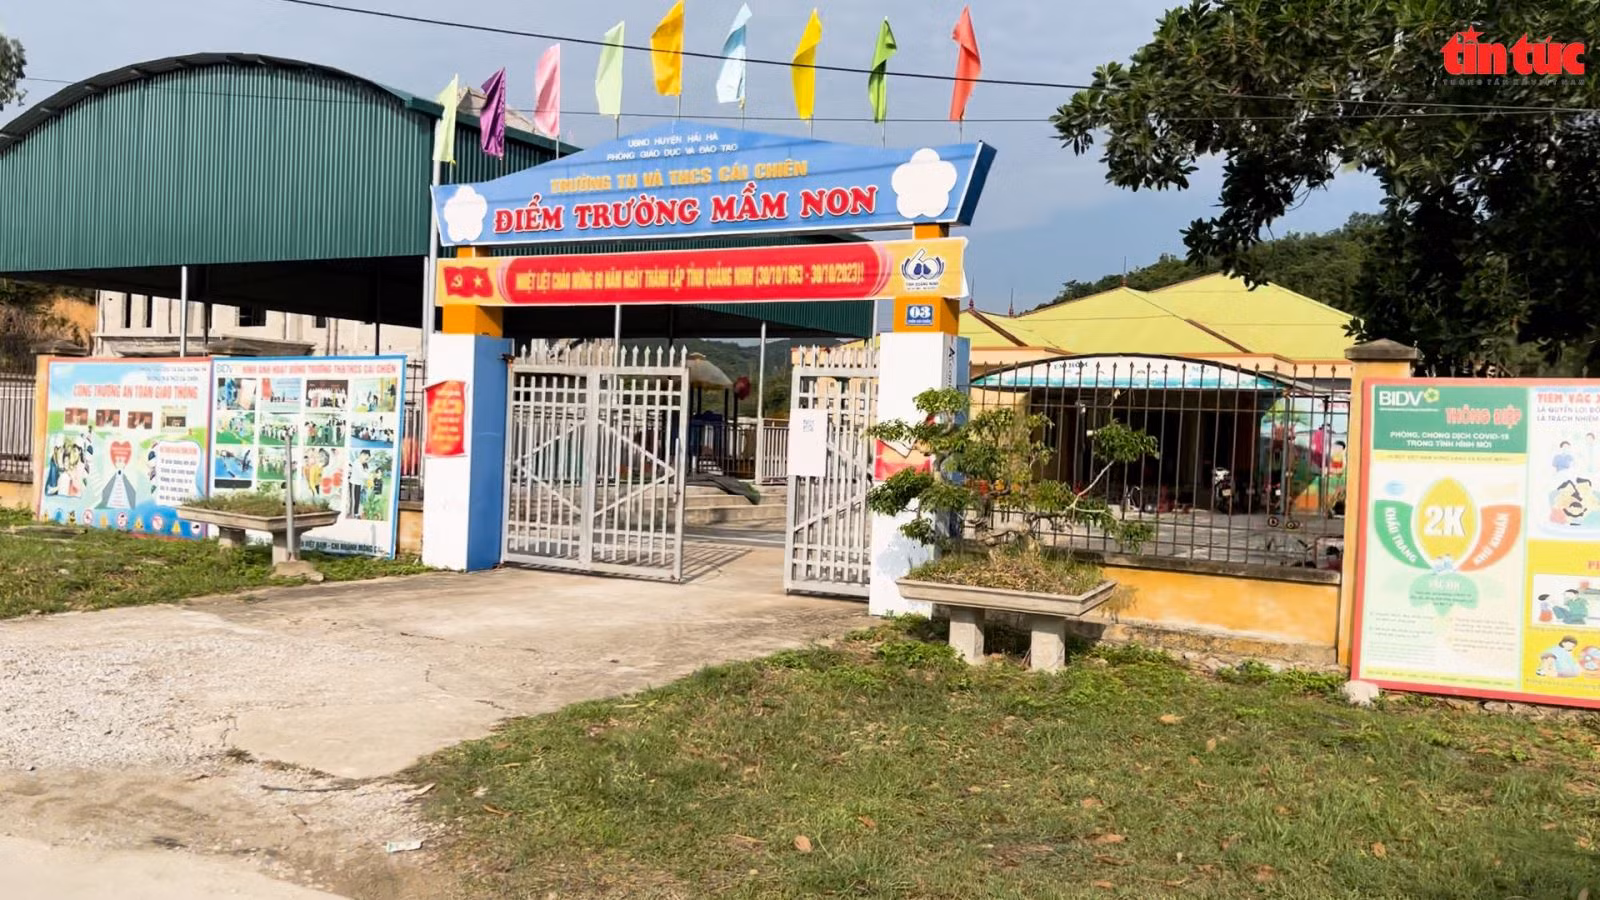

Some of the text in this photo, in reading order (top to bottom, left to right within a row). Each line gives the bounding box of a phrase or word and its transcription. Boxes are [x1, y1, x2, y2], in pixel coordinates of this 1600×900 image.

[654, 135, 683, 146] HUYỆN
[607, 151, 636, 161] PHÒNG
[640, 148, 660, 158] GIÁO
[664, 148, 682, 158] DỤC
[551, 174, 612, 193] TRƯỜNG
[643, 168, 663, 188] VÀ
[669, 167, 712, 185] THCS
[718, 161, 748, 182] CÁI
[754, 158, 808, 180] CHIÊN
[493, 182, 879, 233] ĐIỂM TRƯỜNG MẦM NON
[909, 306, 931, 318] 03
[1379, 391, 1423, 406] BIDV
[1424, 505, 1466, 537] 2K
[1392, 532, 1418, 563] TRANG
